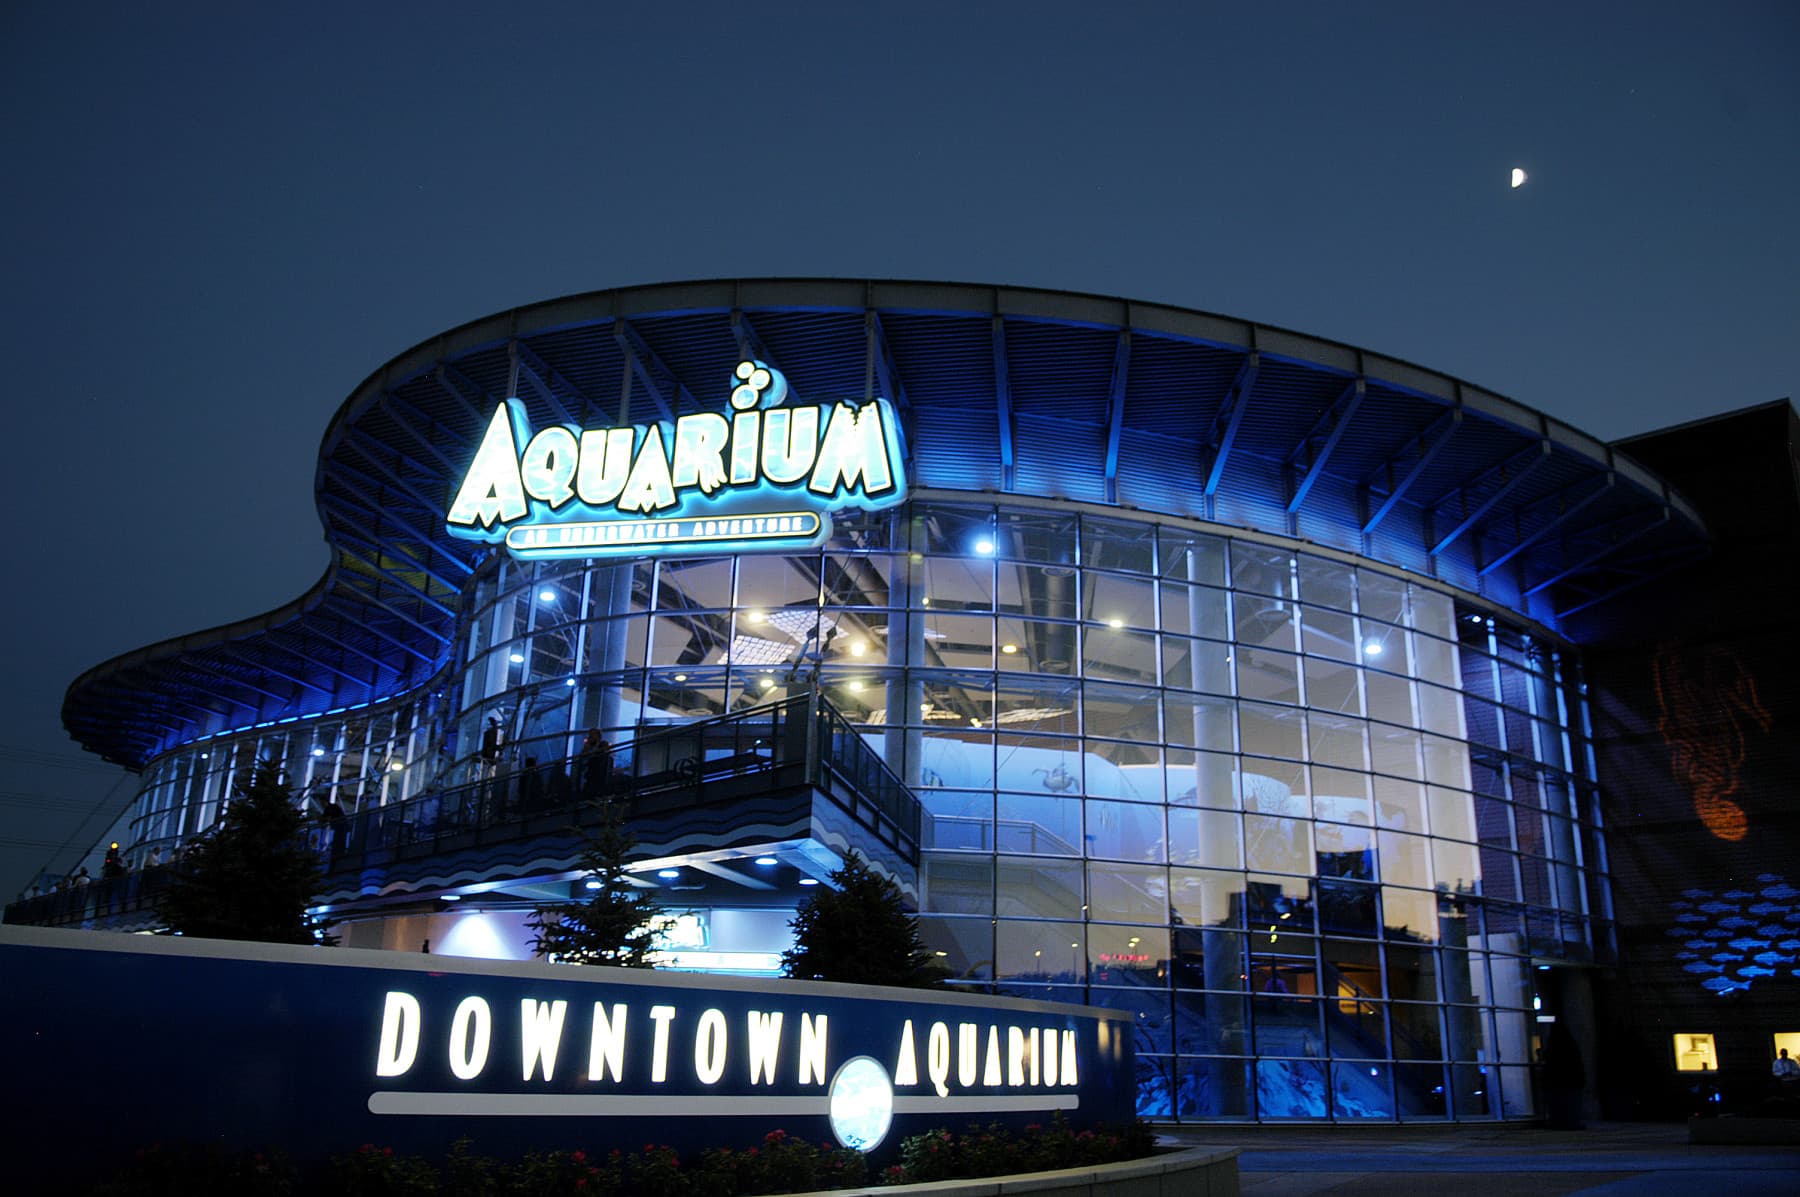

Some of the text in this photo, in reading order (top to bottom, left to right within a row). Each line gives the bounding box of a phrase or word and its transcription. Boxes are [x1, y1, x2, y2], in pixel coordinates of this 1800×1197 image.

[446, 360, 894, 528] AQUARIUM
[692, 517, 803, 536] ADVENTURE
[376, 991, 1079, 1099] DOWNTOWN AQUARIUM
